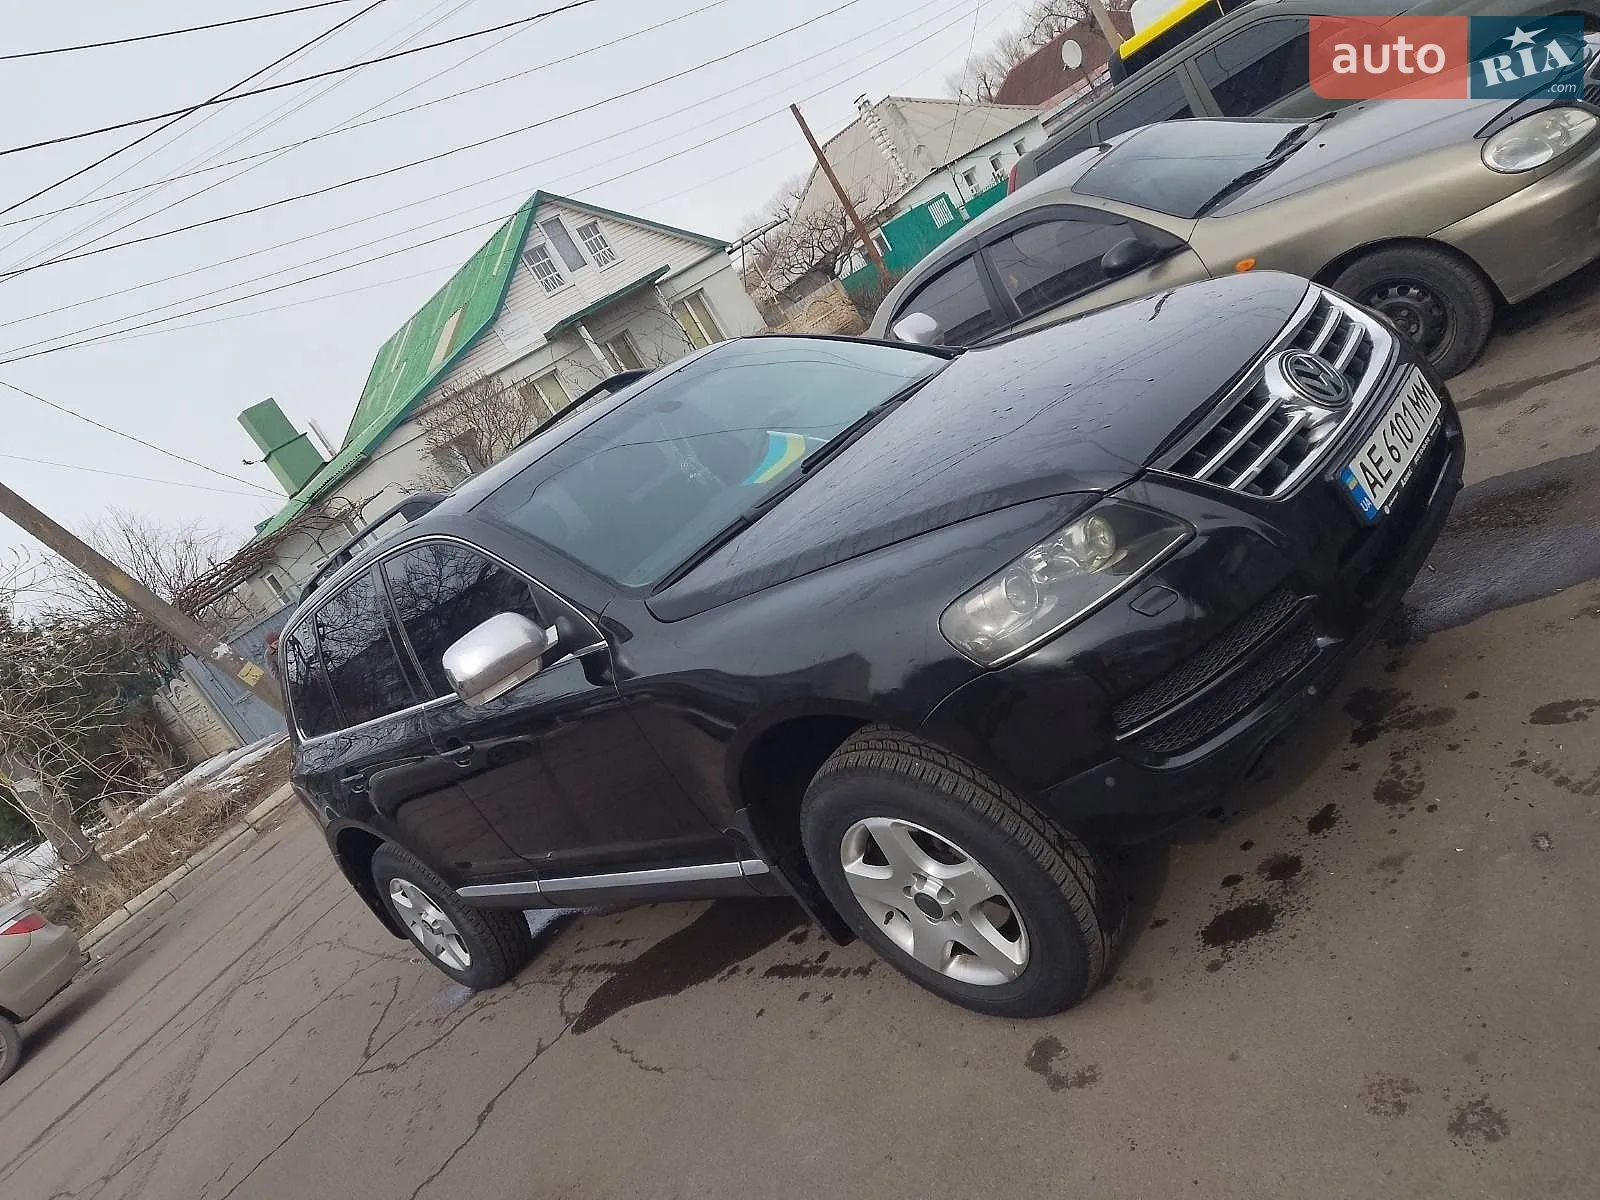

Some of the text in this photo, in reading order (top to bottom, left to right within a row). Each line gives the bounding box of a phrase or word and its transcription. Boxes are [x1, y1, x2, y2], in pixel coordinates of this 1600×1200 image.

[1359, 443, 1393, 499] AE
[1382, 401, 1421, 464] 6101
[1406, 375, 1436, 423] MM
[1360, 497, 1373, 512] UA
